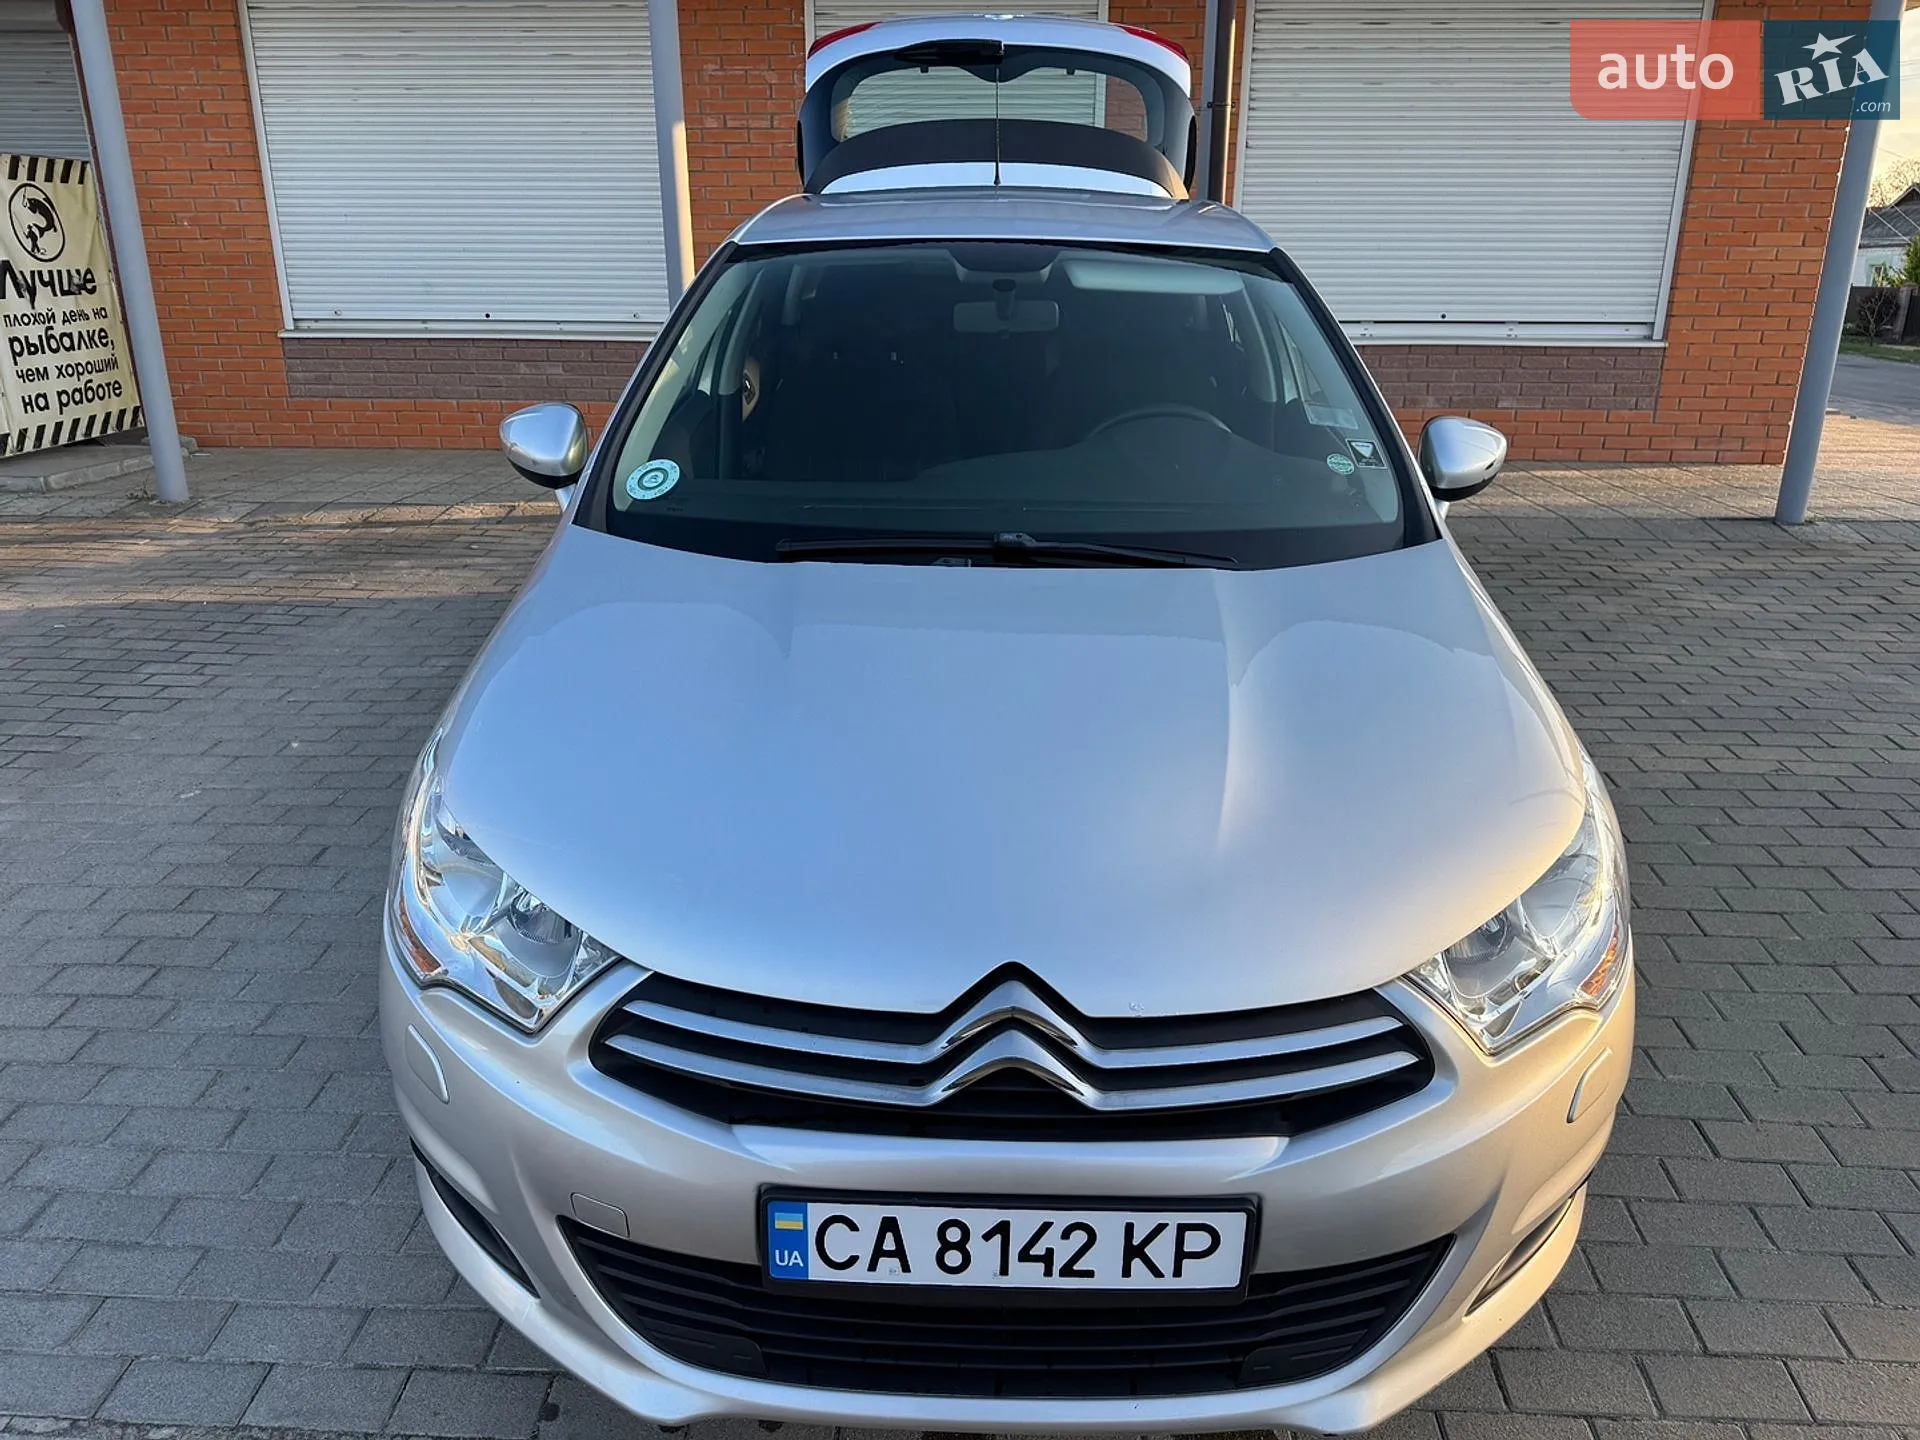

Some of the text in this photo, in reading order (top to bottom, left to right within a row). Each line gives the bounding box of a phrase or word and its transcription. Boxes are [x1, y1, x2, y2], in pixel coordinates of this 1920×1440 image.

[0, 260, 97, 310] Лучше
[3, 307, 56, 327] плохой
[61, 309, 90, 326] день
[8, 325, 115, 366] рыбалке,
[16, 353, 119, 383] чем хороший
[21, 378, 122, 415] на работе
[775, 1249, 804, 1268] UA
[814, 1213, 1222, 1280] CA 8142 KP
